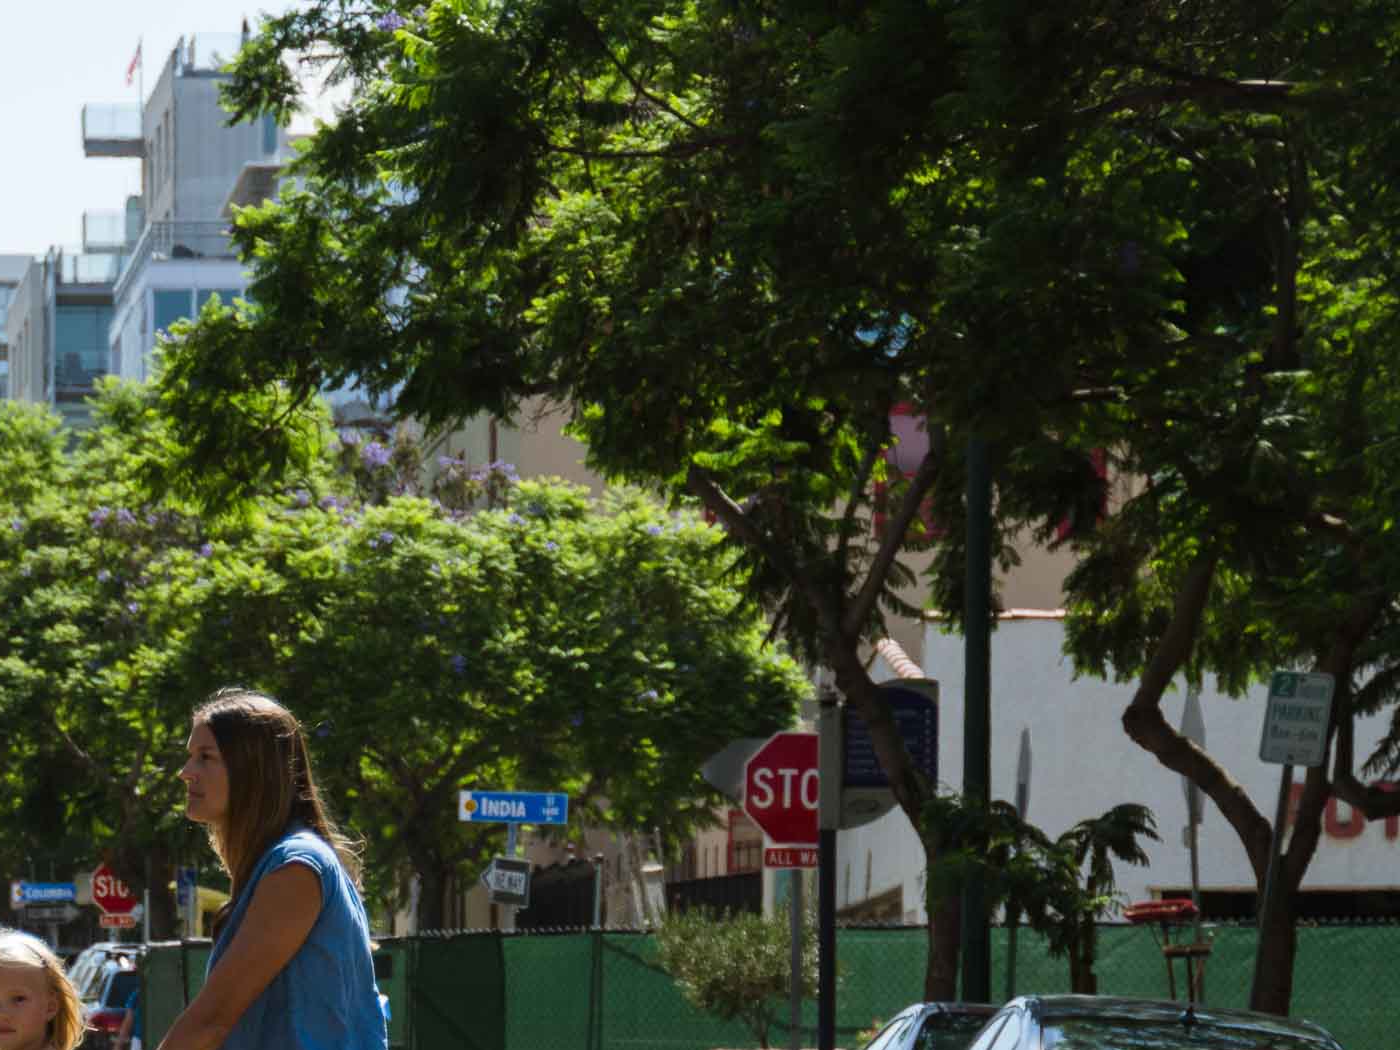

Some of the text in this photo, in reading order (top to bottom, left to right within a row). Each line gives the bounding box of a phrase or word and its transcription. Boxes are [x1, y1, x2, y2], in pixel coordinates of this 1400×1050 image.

[752, 767, 819, 809] STO
[481, 797, 527, 817] INDIA
[769, 851, 818, 865] ALL WA
[96, 876, 129, 898] STO
